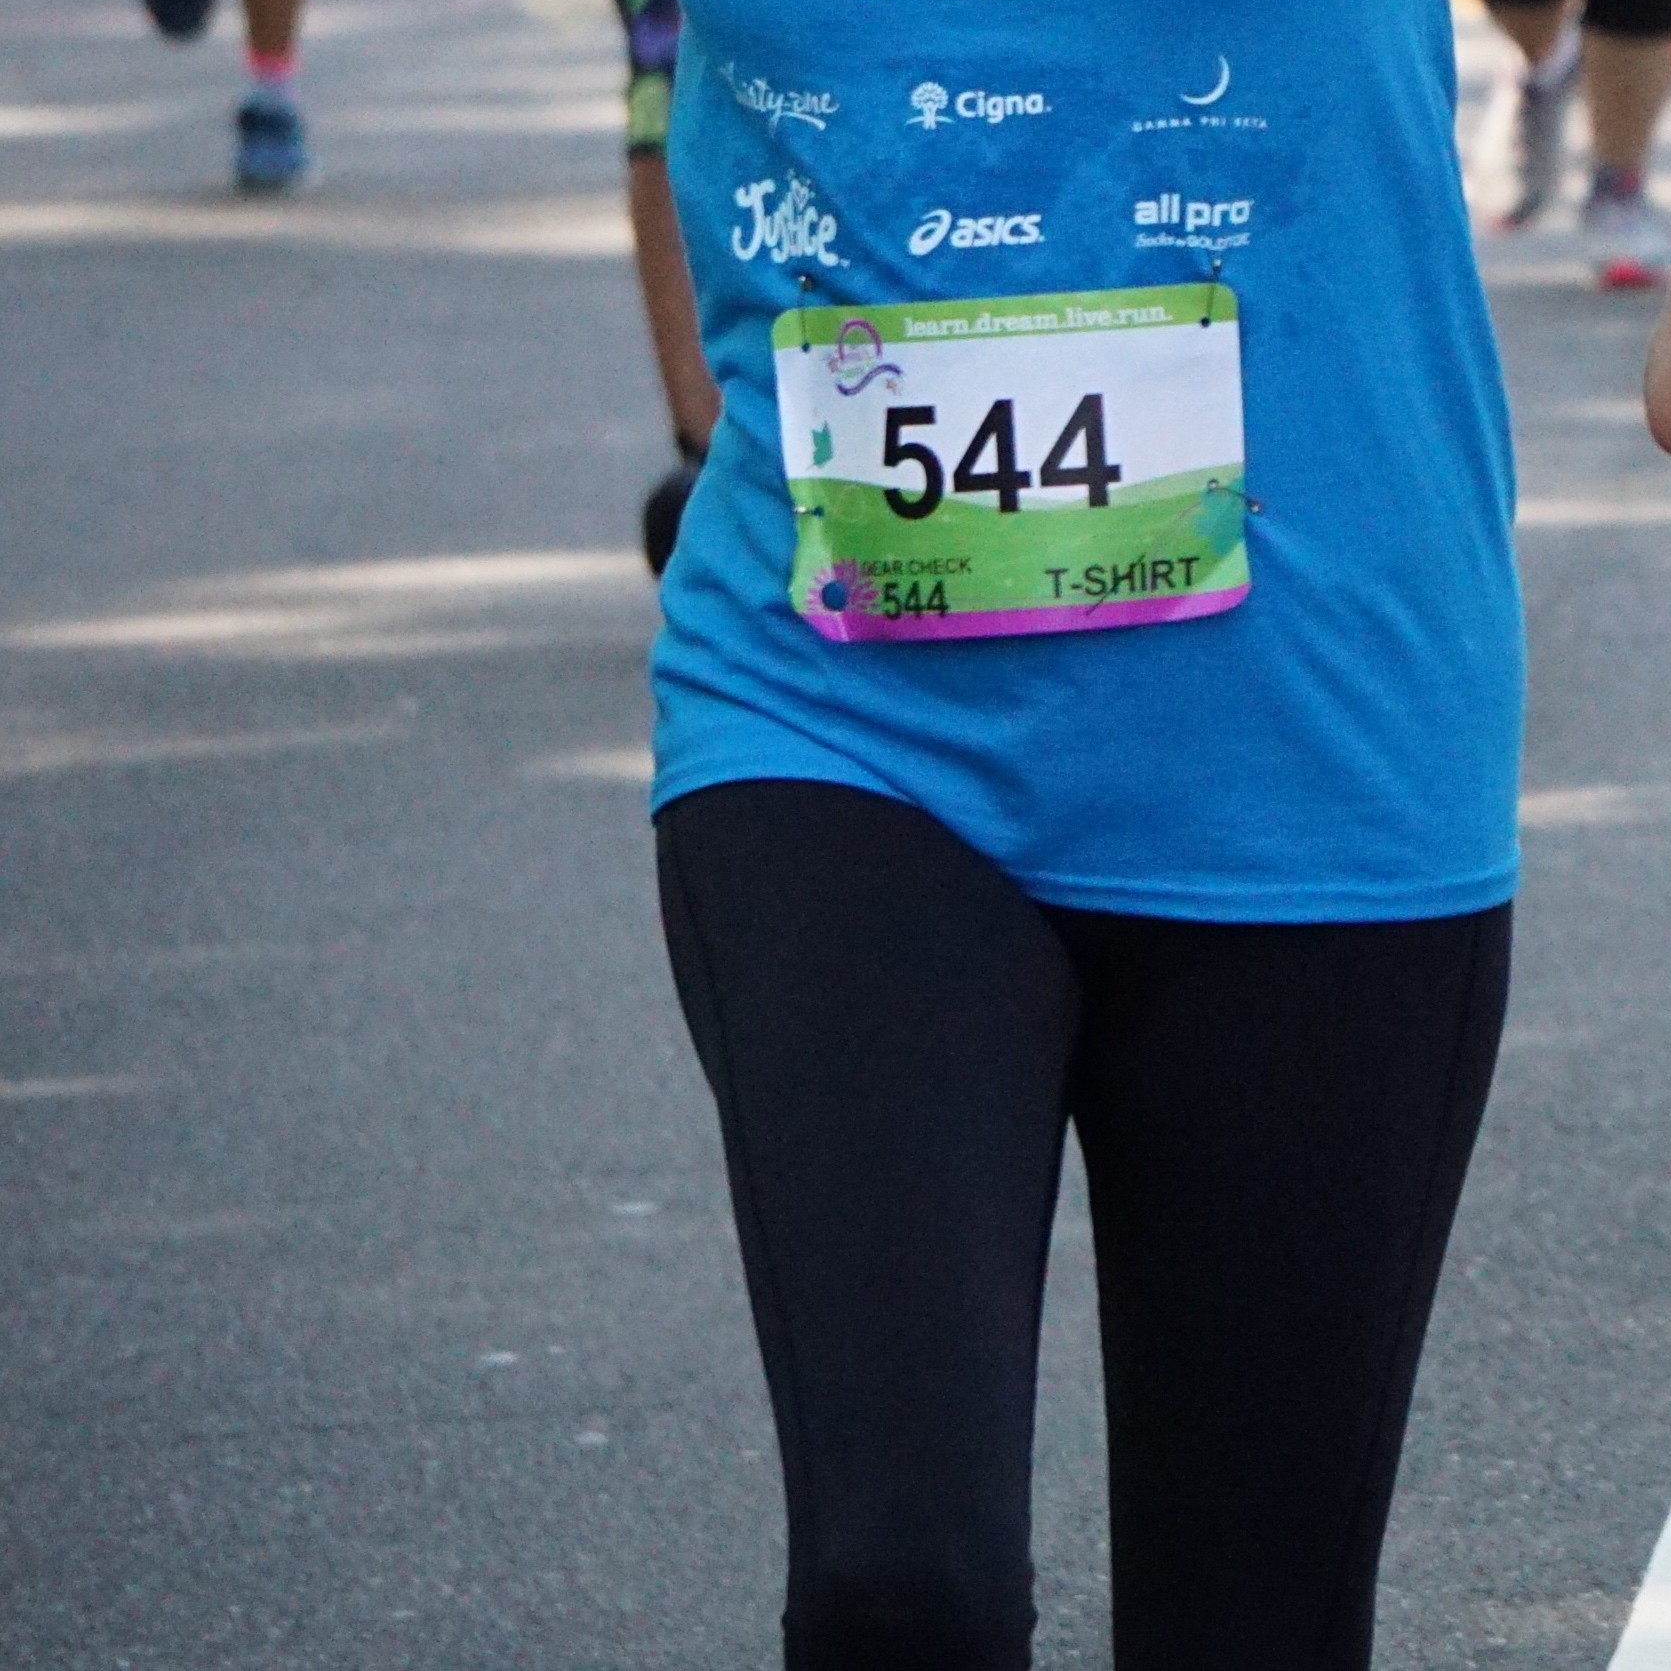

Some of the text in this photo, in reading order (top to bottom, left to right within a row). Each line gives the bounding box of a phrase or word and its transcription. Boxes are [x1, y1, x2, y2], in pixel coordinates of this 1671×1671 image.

[954, 91, 1046, 122] Cigna
[732, 176, 838, 266] Justice
[950, 214, 1042, 248] asics
[1134, 193, 1251, 232] all pro
[883, 393, 1122, 521] 544
[908, 557, 972, 576] CHECK
[1045, 556, 1200, 599] T-SHIRT
[883, 579, 949, 620] 544
